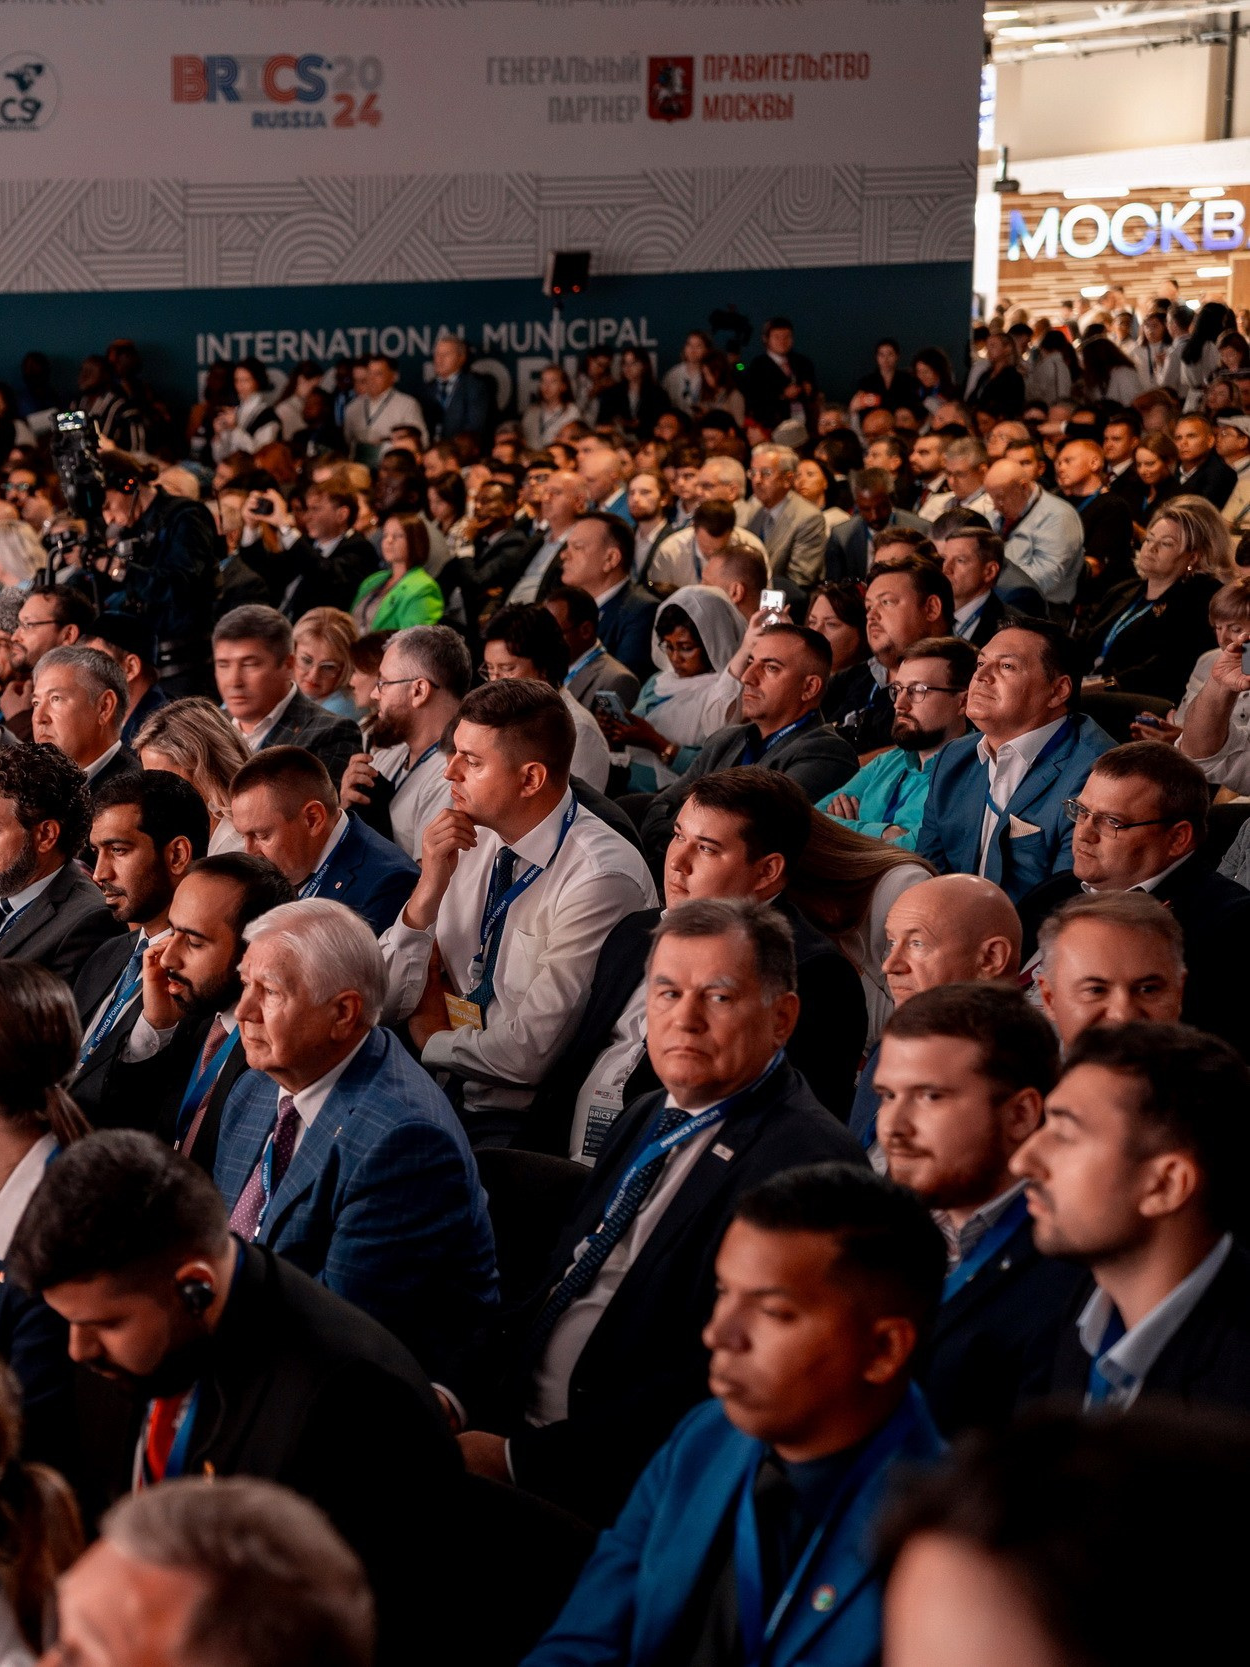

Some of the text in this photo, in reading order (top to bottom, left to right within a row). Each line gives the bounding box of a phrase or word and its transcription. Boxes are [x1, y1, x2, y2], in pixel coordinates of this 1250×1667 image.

[171, 54, 384, 105] BRICS 20
[485, 50, 642, 86] ГЕНЕРАЛЬНЫЙ
[701, 51, 871, 83] ПРАВИТЕЛЬСТВО
[251, 92, 383, 129] RUSSIA 24
[548, 95, 642, 124] ПАРТНЕР
[701, 92, 795, 122] МОСКВЫ
[1007, 199, 1250, 261] МОСКВ
[196, 317, 658, 365] INTERNATIONA MUNICIPAL
[315, 864, 330, 883] FORUM
[522, 866, 541, 884] IMBRIC
[493, 900, 508, 919] FORUM
[95, 998, 125, 1042] IMBRICS FORUM
[589, 1110, 610, 1120] BRICS
[660, 1109, 721, 1148] IMBRICS FORUM
